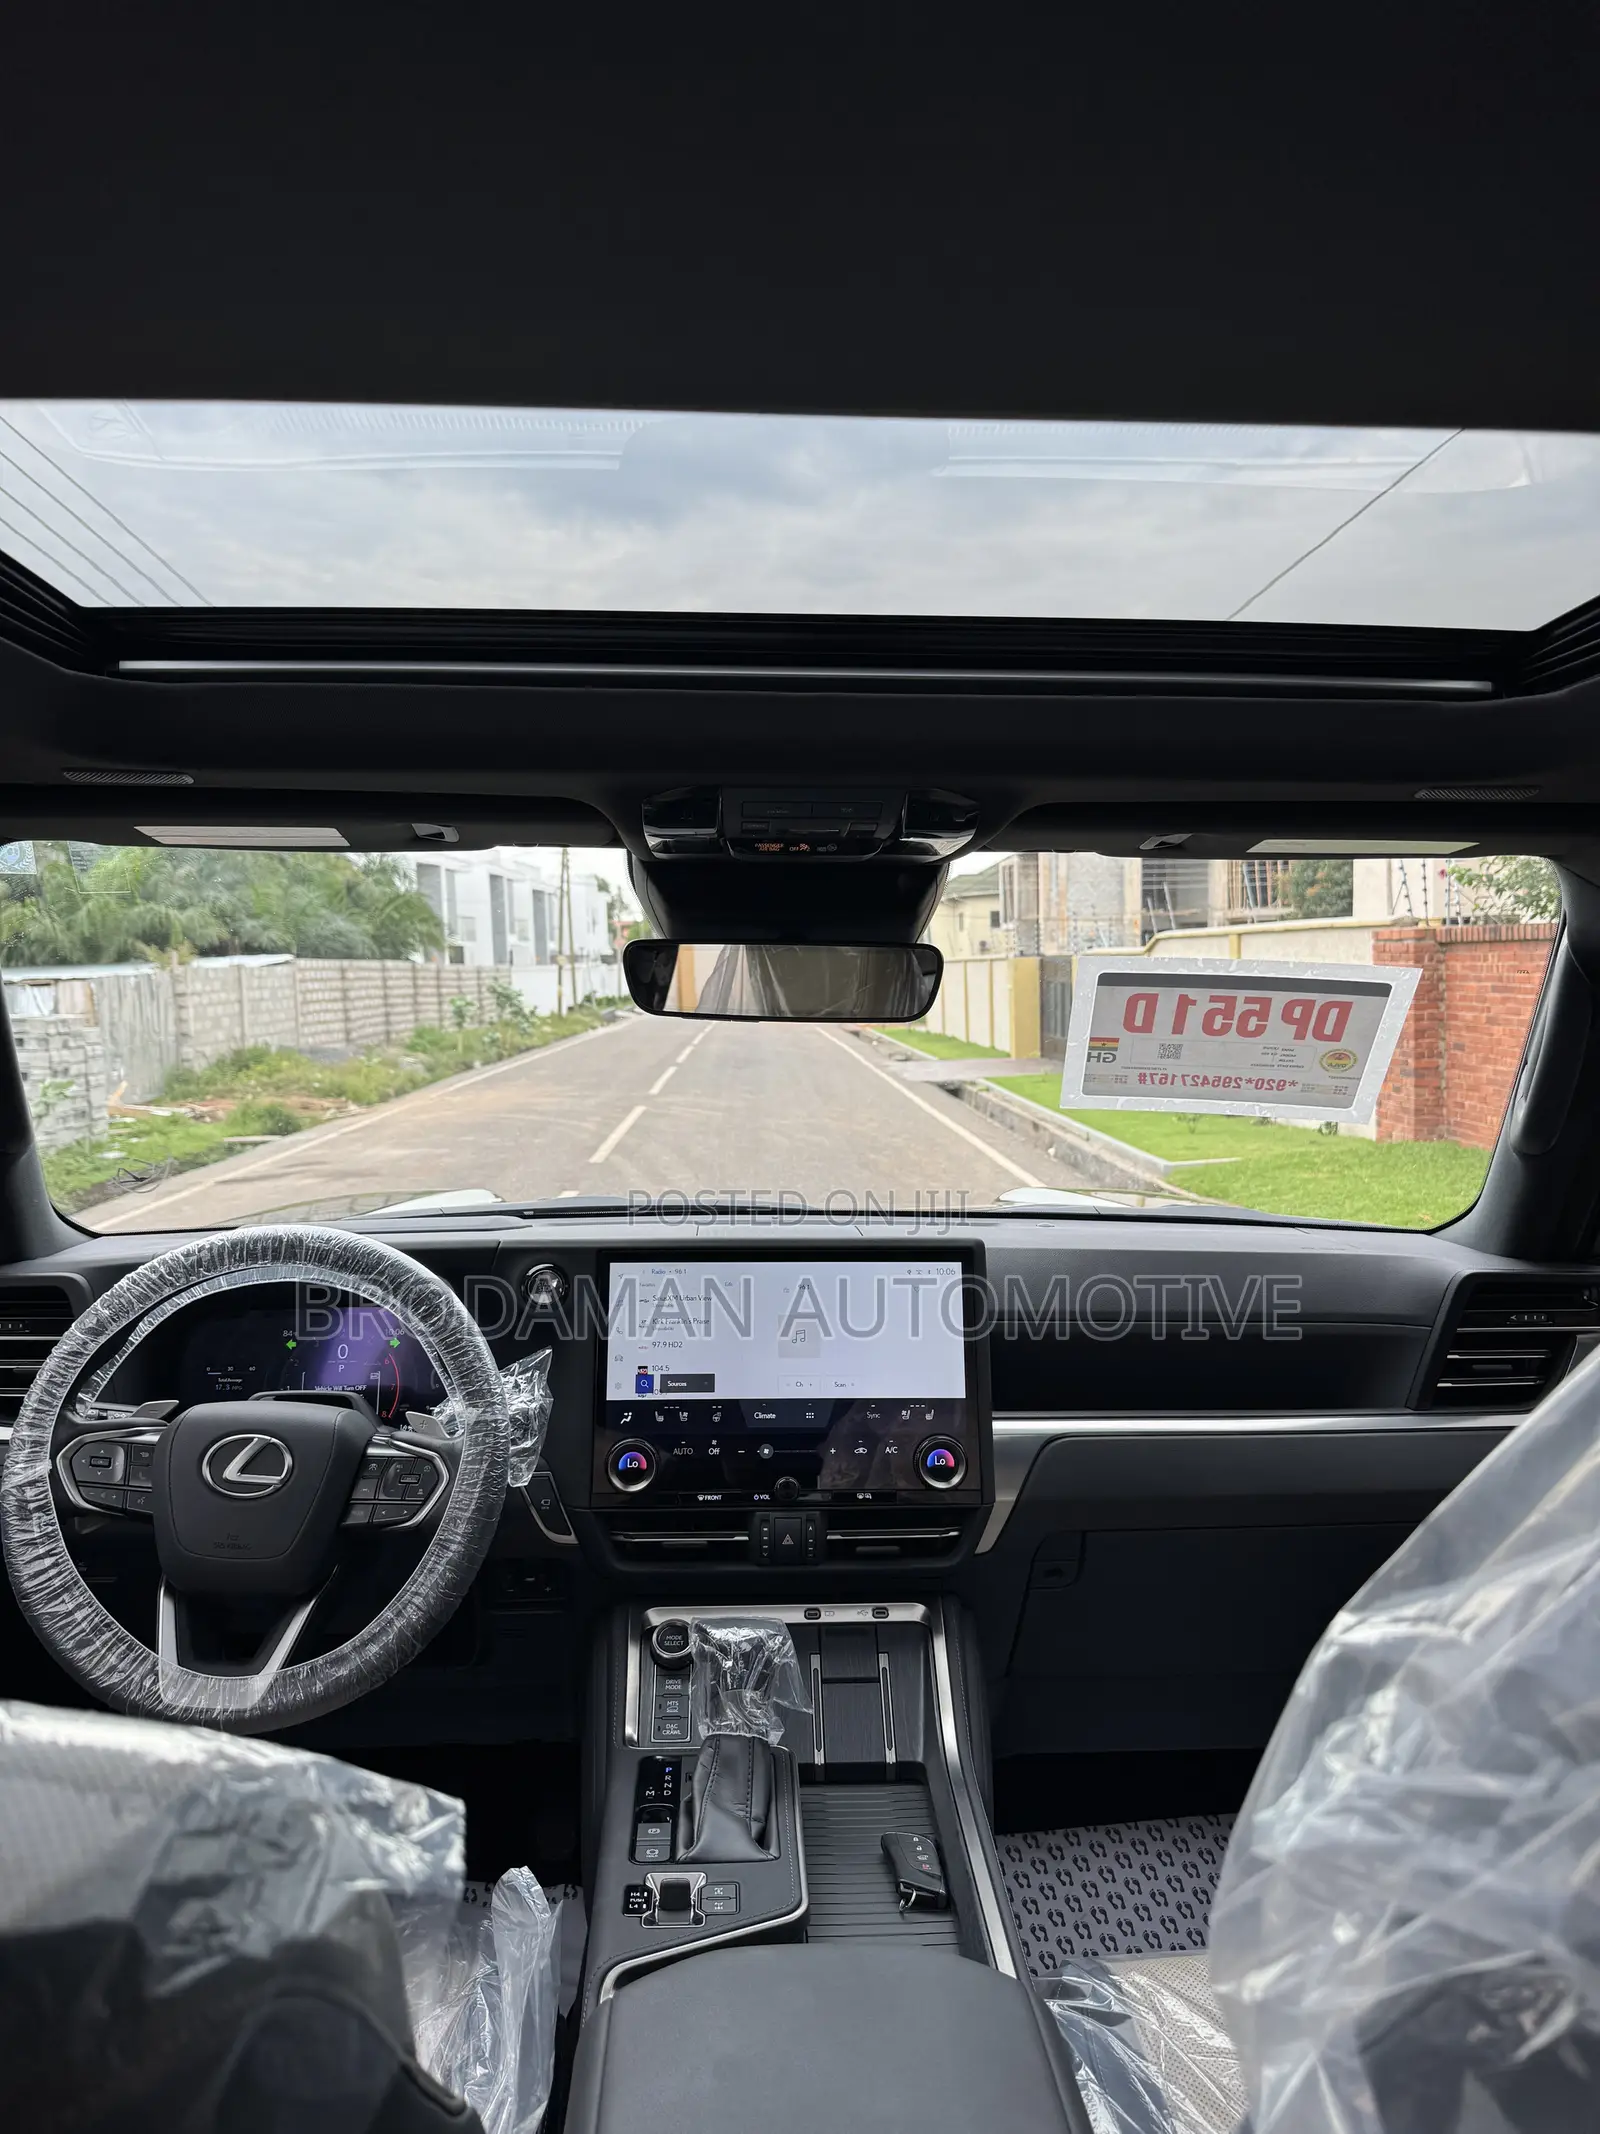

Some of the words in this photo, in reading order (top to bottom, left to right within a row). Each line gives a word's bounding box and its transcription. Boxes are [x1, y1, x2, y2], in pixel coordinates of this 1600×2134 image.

[935, 1267, 956, 1276] 10:06
[679, 1294, 698, 1302] Urban
[651, 1341, 667, 1349] 97.9
[668, 1341, 683, 1349] HD2
[337, 1343, 349, 1360] 0
[338, 1364, 345, 1373] P
[314, 1384, 332, 1392] Vehicle
[333, 1384, 343, 1392] Will
[343, 1384, 355, 1392] Turn
[667, 1380, 687, 1388] Sources
[753, 1411, 777, 1420] Climate
[866, 1411, 881, 1420] Sync
[672, 1447, 694, 1455] AUTO
[708, 1447, 721, 1455] Off
[884, 1446, 898, 1454] A/C
[627, 1458, 639, 1468] Lo
[934, 1455, 946, 1465] Lo
